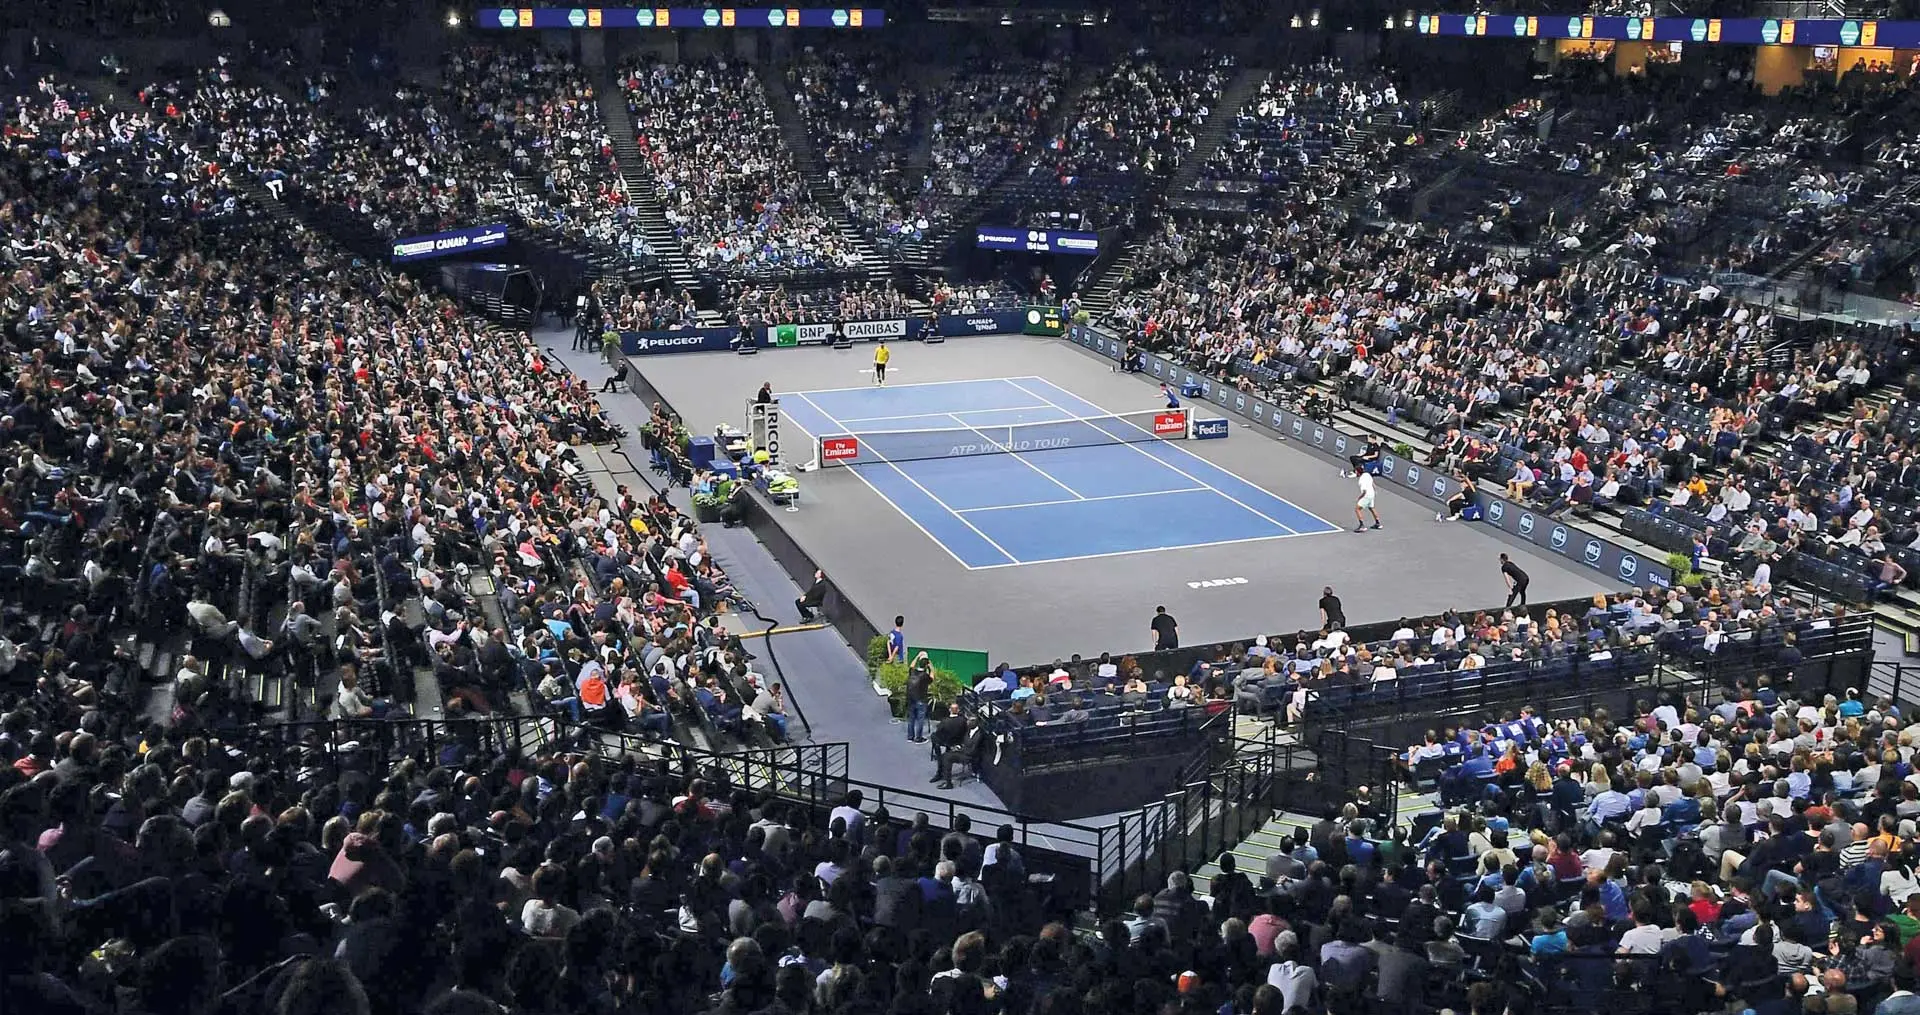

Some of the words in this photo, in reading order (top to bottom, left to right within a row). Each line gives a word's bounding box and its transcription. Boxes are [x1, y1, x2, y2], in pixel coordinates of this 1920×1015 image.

[436, 235, 469, 250] CANAL+
[985, 235, 1017, 243] PEUGEOT
[966, 317, 994, 326] CANAL+
[800, 327, 826, 339] BNP
[848, 322, 900, 336] PARIBAS
[650, 336, 705, 347] PEUGEOT
[1155, 422, 1183, 431] Emirates
[1198, 423, 1228, 435] FedEx
[767, 412, 779, 466] RICOH
[825, 447, 856, 457] Emirates
[835, 443, 846, 451] Fly
[949, 445, 977, 456] ATP
[980, 440, 1031, 453] WORLD
[1034, 437, 1071, 449] TOUR
[1187, 576, 1249, 589] PARIS
